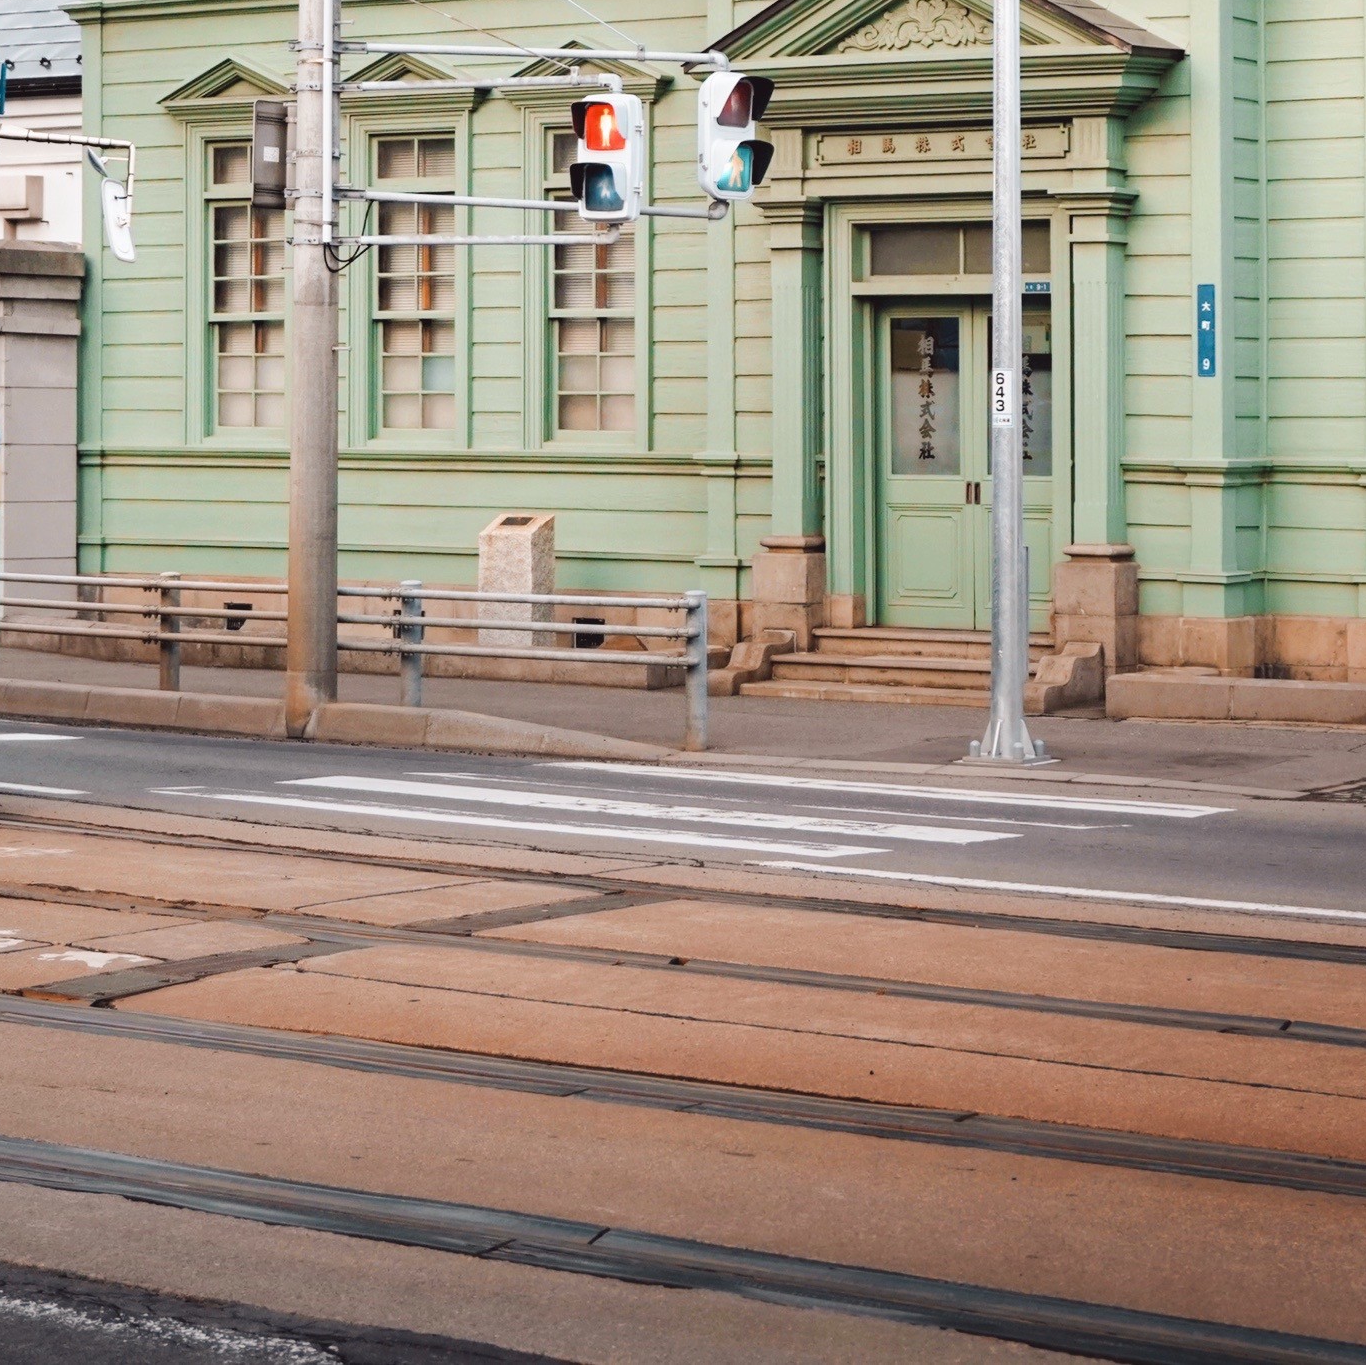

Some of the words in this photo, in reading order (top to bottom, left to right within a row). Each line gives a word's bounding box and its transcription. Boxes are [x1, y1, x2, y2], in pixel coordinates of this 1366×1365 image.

[1201, 301, 1211, 331] 大町
[1202, 358, 1210, 370] 9
[917, 334, 936, 460] 相馬株式会社
[995, 372, 1005, 412] 643
